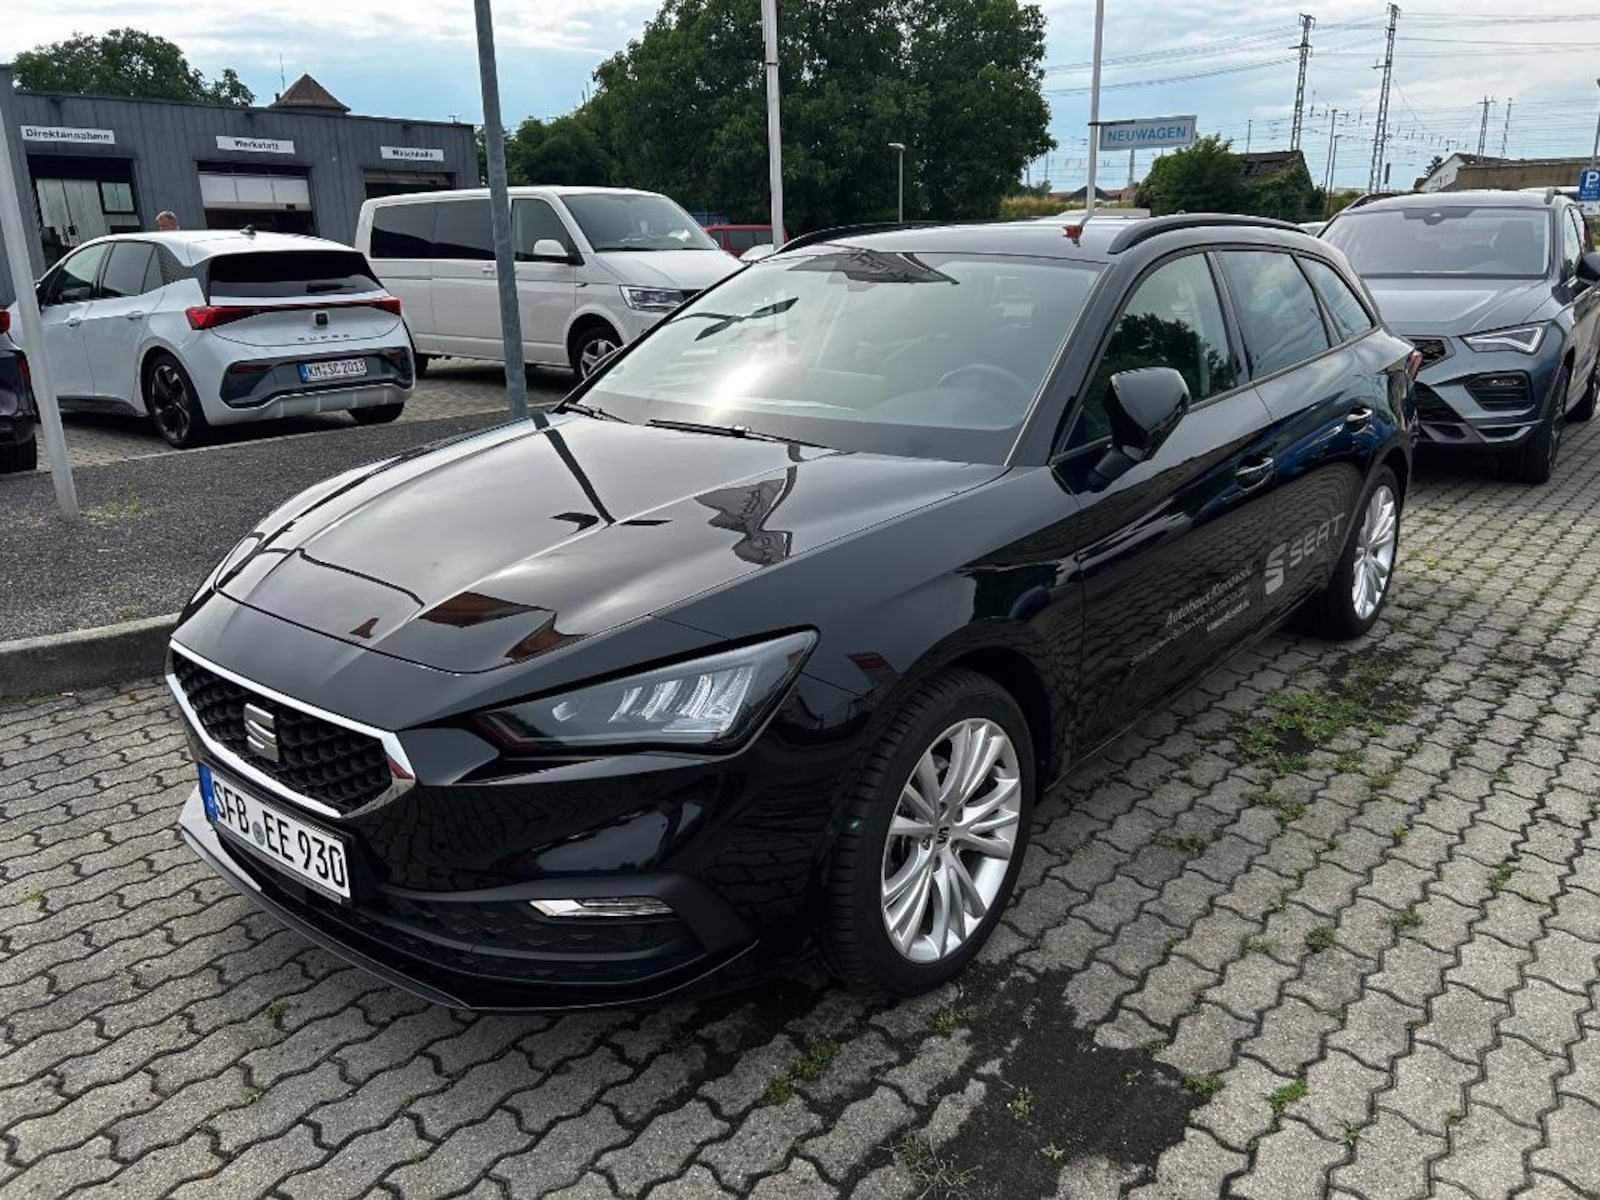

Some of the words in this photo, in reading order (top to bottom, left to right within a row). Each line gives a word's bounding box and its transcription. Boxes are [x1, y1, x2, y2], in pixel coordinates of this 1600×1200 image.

[1107, 126, 1186, 142] NEUWAGEN
[308, 363, 322, 377] KM
[1289, 512, 1346, 568] SEAT
[213, 780, 249, 834] SFB
[262, 810, 295, 863] EE
[298, 829, 346, 888] 930
